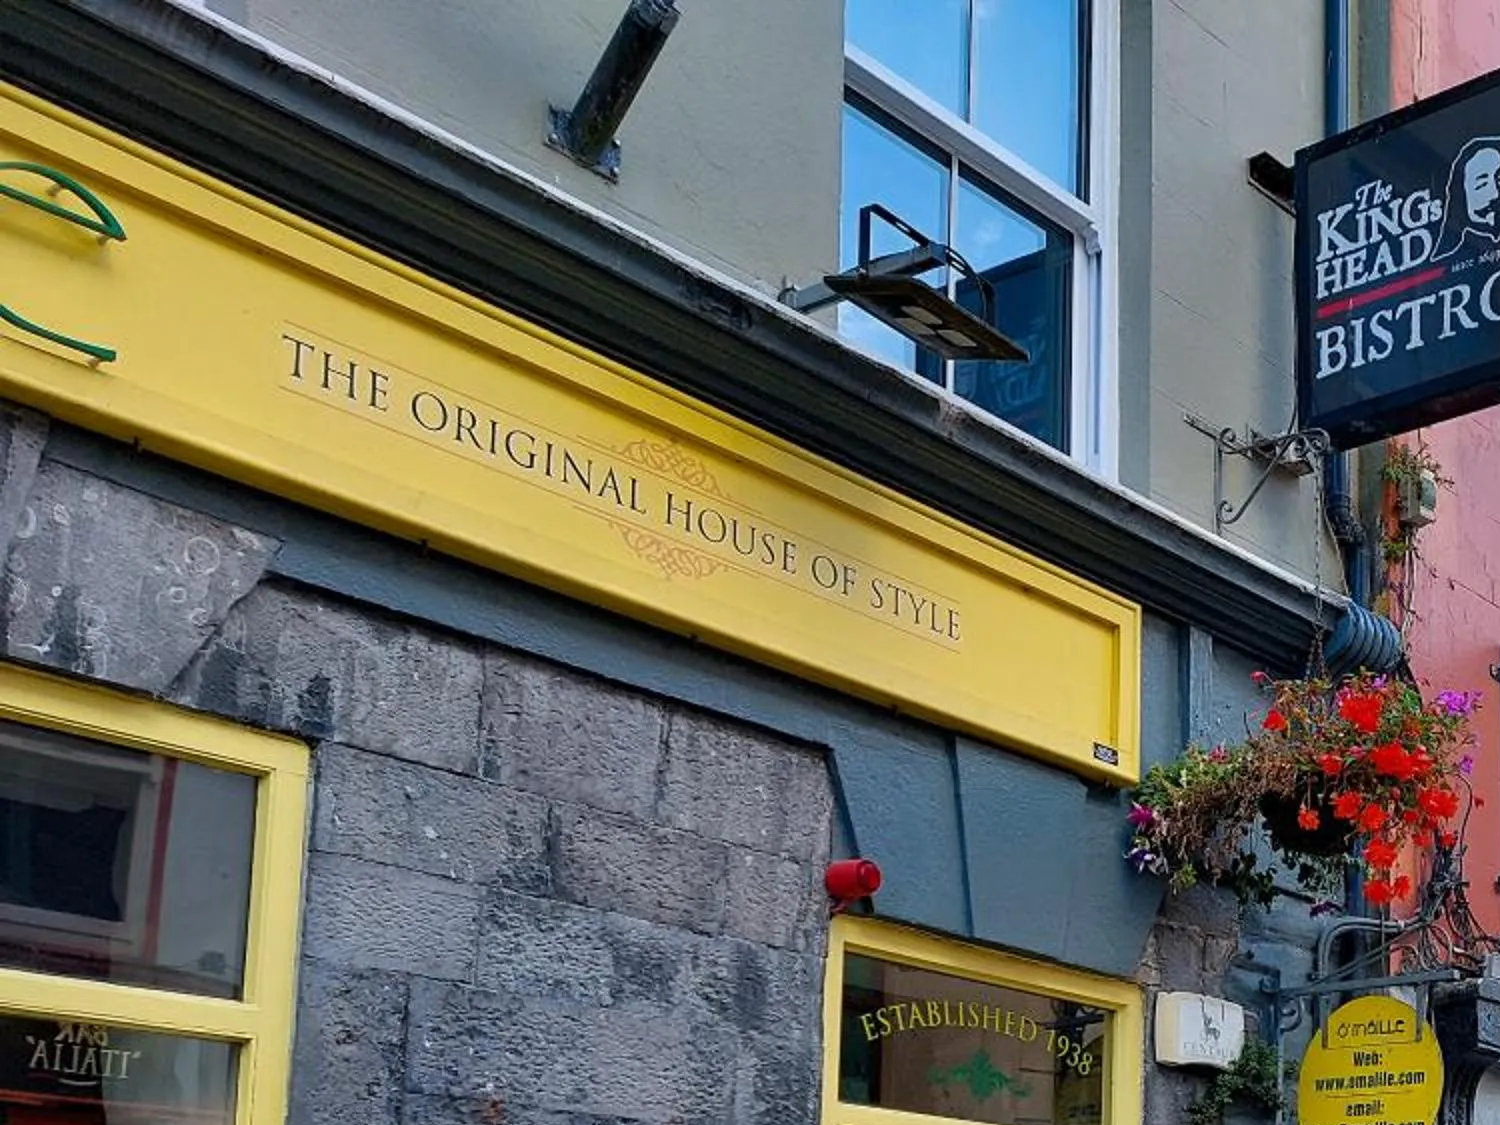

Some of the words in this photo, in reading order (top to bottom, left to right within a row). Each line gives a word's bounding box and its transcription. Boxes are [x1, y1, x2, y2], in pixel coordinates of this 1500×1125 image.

[1356, 180, 1392, 212] The
[1316, 229, 1433, 299] HEAD
[282, 334, 389, 413] THE
[411, 390, 647, 515] ORIGINAL
[666, 491, 798, 575] HOUSE
[811, 554, 858, 597] OF
[871, 577, 962, 641] STYLE
[860, 1000, 1038, 1042] ESTABLISHED
[1045, 1029, 1093, 1075] 1938
[1353, 1051, 1383, 1067] Web:
[1345, 1100, 1385, 1117] email:
